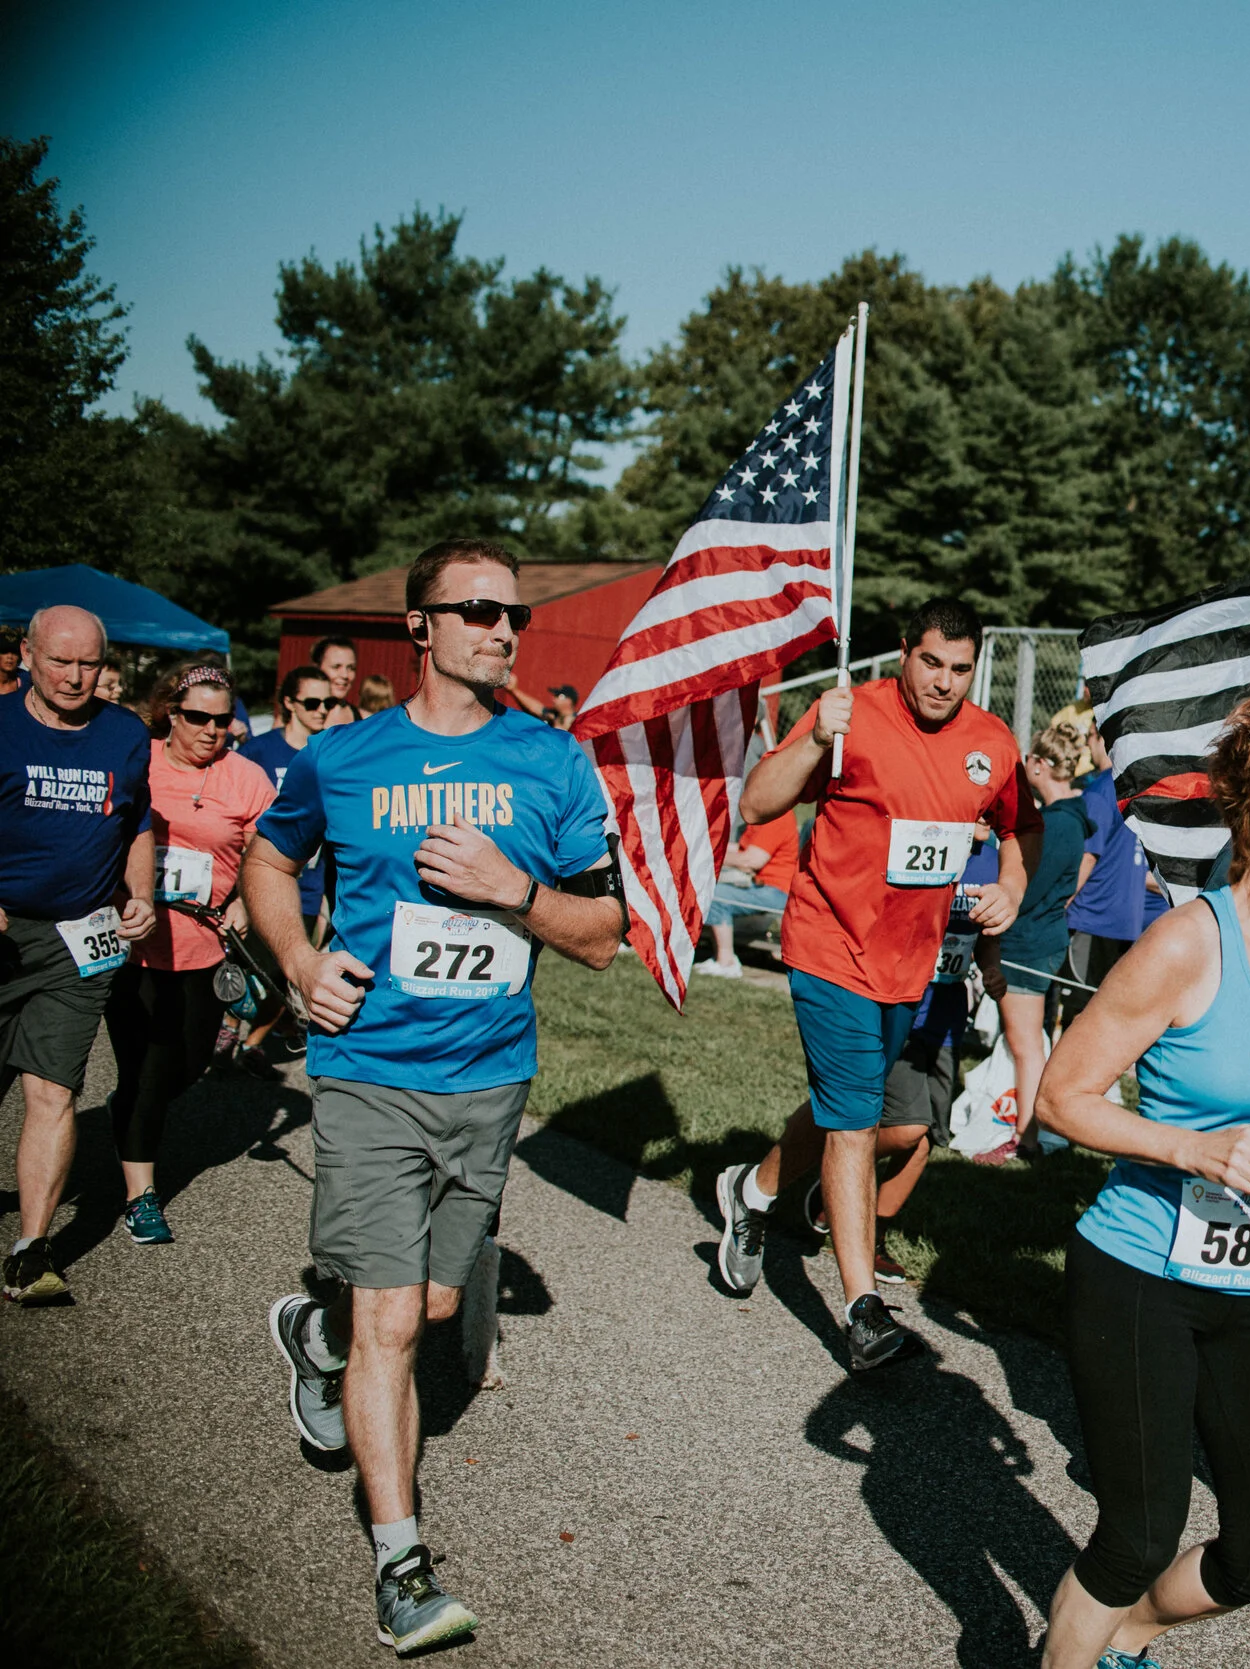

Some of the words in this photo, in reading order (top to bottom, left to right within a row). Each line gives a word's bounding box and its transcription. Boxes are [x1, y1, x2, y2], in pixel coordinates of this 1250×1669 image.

[26, 765, 56, 780] WILL
[57, 768, 82, 783] RUN
[83, 770, 106, 785] FOR
[26, 780, 37, 797] A
[55, 801, 69, 811] Run
[76, 802, 93, 814] York,
[94, 804, 103, 813] PA
[372, 782, 514, 830] PANTHERS
[905, 845, 949, 872] 231
[155, 867, 182, 891] 71
[84, 929, 120, 961] 355
[414, 940, 495, 981] 272
[401, 981, 447, 996] Blizzard
[449, 986, 472, 997] Run
[475, 986, 499, 997] 2019
[1180, 1268, 1231, 1285] Blizzard
